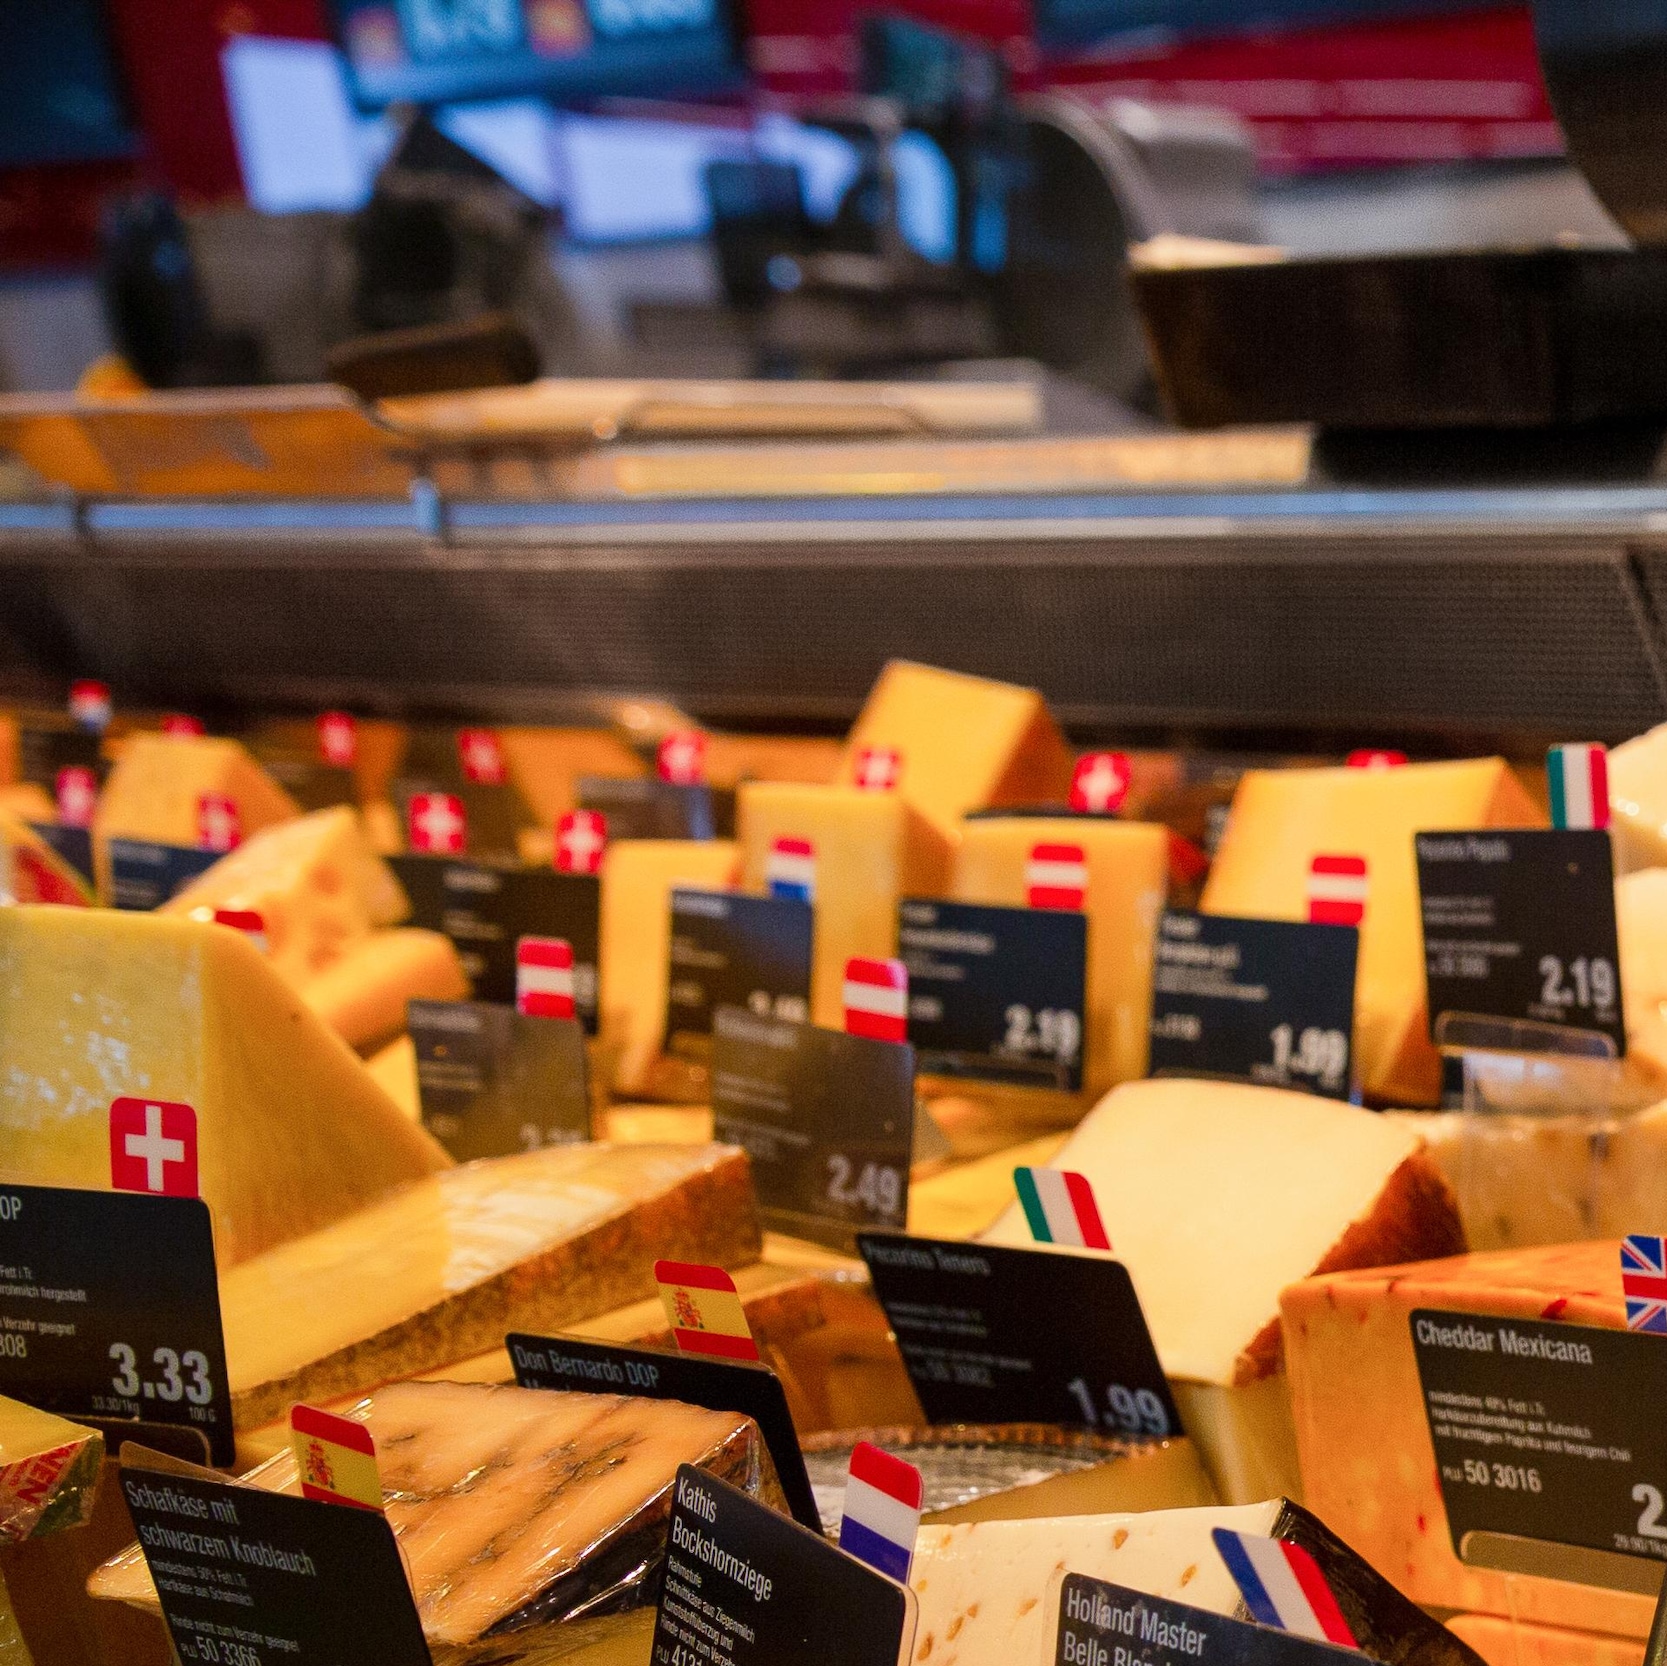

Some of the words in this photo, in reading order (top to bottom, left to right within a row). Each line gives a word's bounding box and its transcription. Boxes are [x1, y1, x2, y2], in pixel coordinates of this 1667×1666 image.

[1539, 954, 1615, 1008] 2.19
[514, 1344, 548, 1371] Don
[550, 1350, 624, 1383] Bernardo
[625, 1360, 660, 1388] DOP
[1416, 1319, 1497, 1352] Cheddar
[1499, 1328, 1594, 1365] Mexicana
[108, 1342, 213, 1405] 3.33
[1067, 1377, 1169, 1435] 1.99
[678, 1476, 717, 1524] Kathis
[1464, 1459, 1490, 1486] 50
[1492, 1463, 1543, 1494] 3016
[125, 1480, 208, 1521] Schafkäse
[211, 1498, 240, 1526] mit
[140, 1522, 228, 1561] schwarzem
[231, 1537, 317, 1579] Knoblauch
[672, 1515, 773, 1603] Bockshornziege
[1066, 1587, 1136, 1638] Holland
[1140, 1610, 1208, 1658] Master
[195, 1635, 220, 1664] 50
